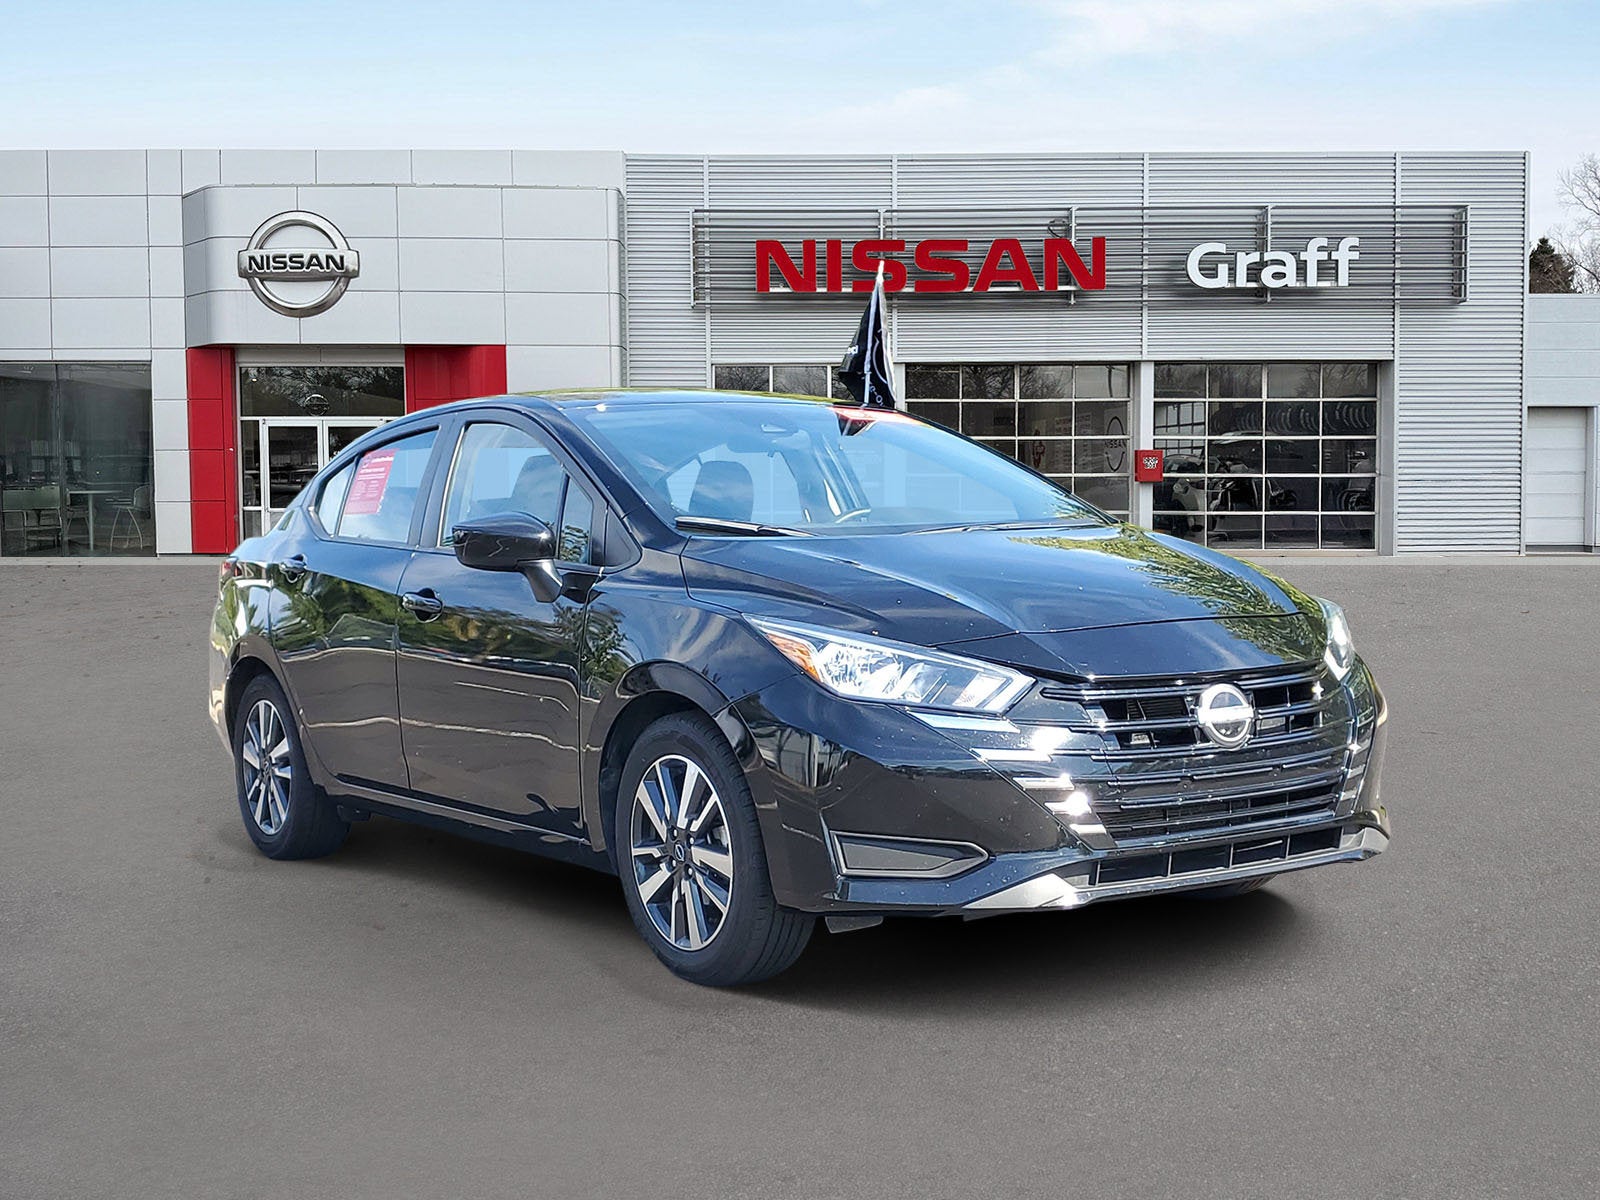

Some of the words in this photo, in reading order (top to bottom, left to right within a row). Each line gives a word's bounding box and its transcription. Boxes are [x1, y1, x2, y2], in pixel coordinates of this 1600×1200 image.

[247, 254, 345, 271] NISSAN
[755, 236, 1107, 293] NISSAN
[1186, 237, 1360, 289] Graff
